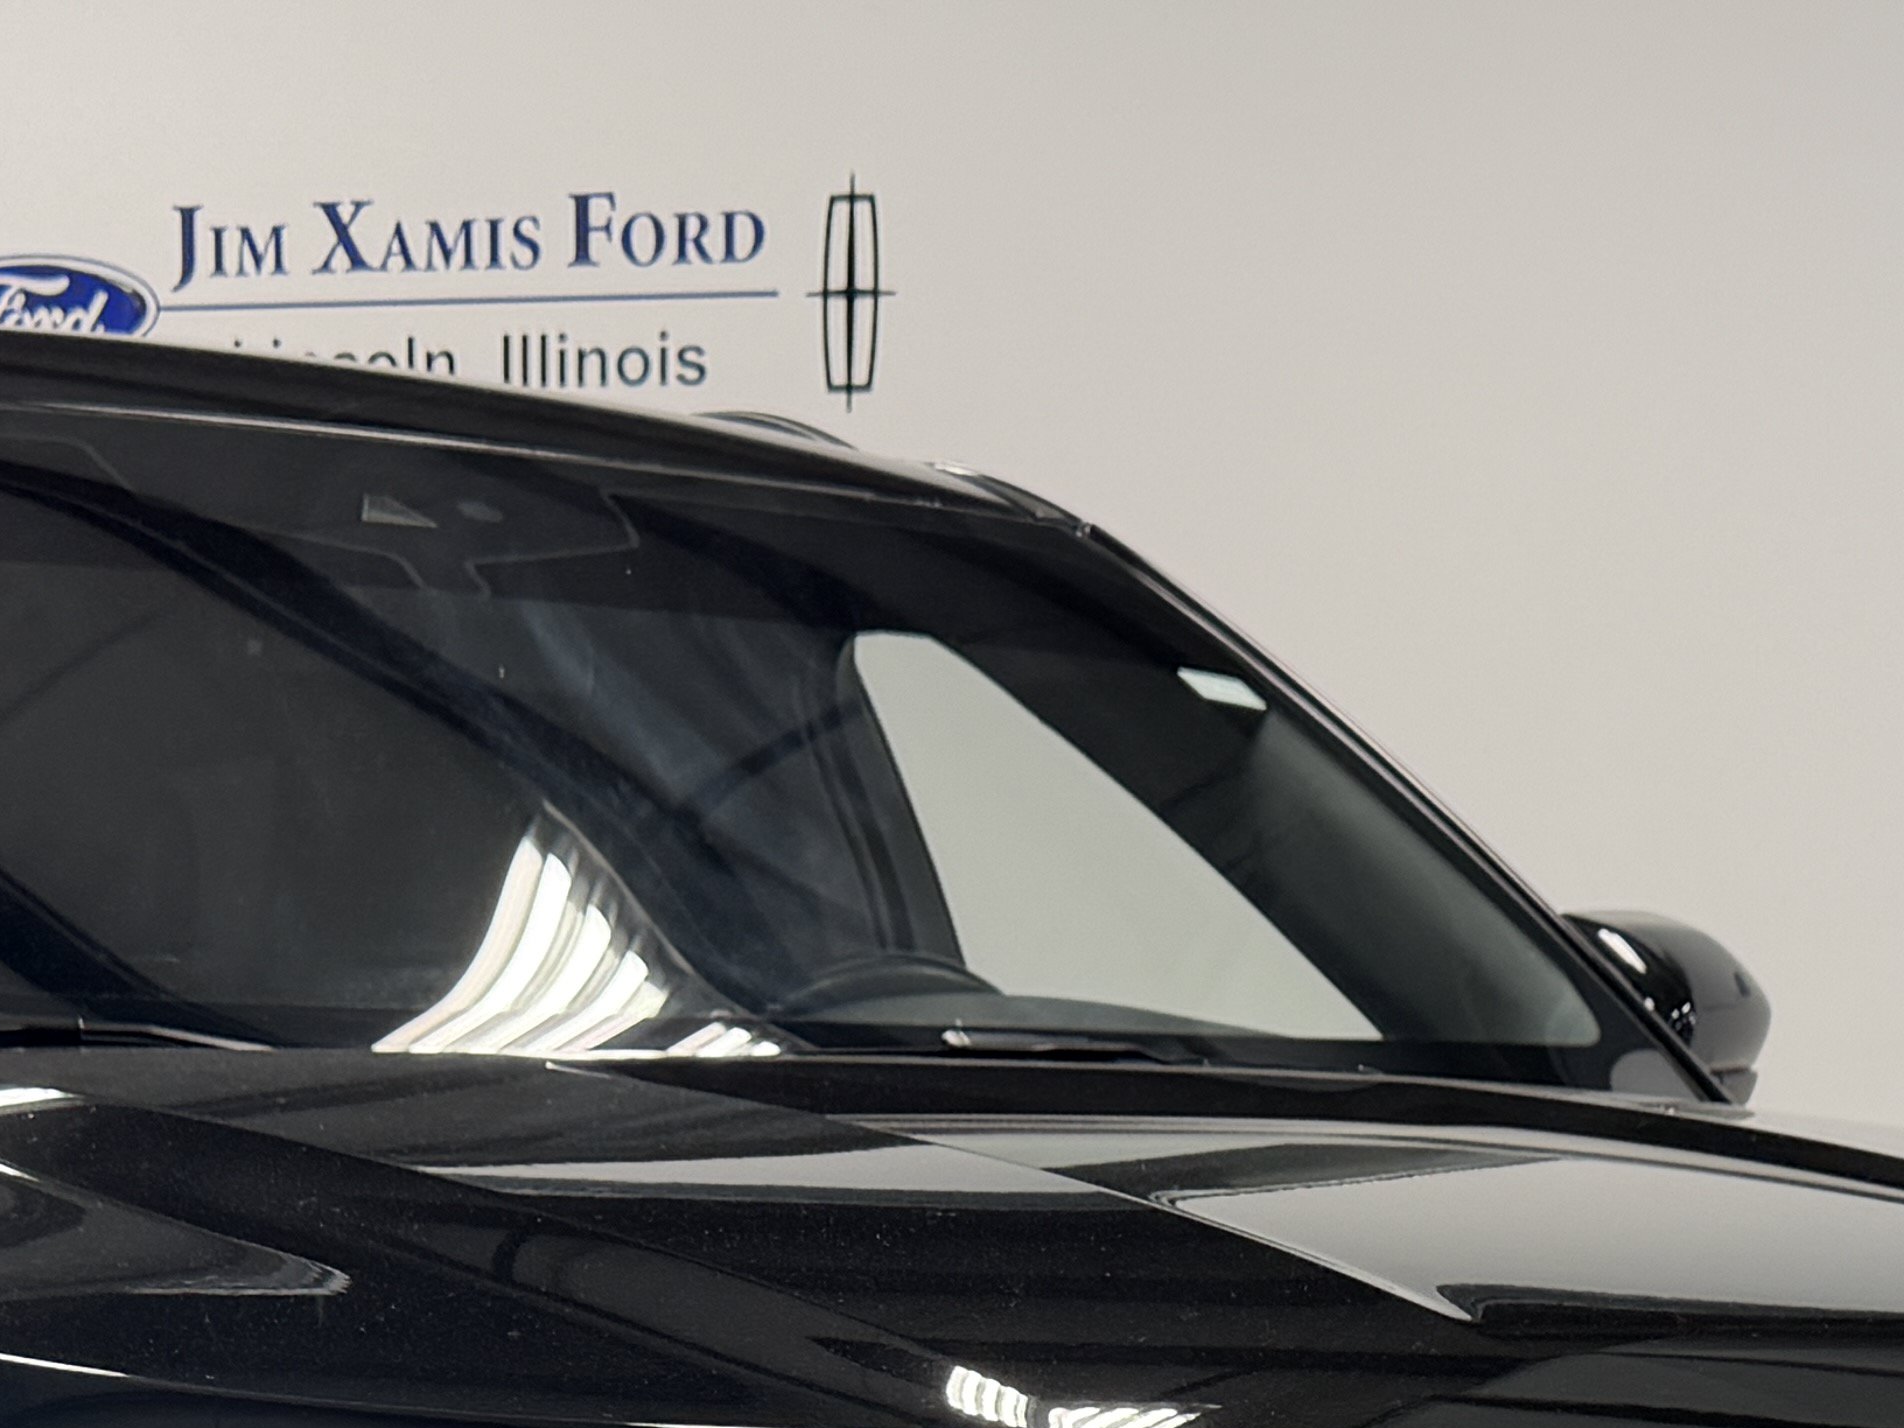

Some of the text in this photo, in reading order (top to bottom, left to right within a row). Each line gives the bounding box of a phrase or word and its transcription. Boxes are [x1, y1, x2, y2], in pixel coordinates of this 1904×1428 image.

[171, 191, 766, 293] JIM XAMIS FORD
[502, 329, 708, 389] Illinois
